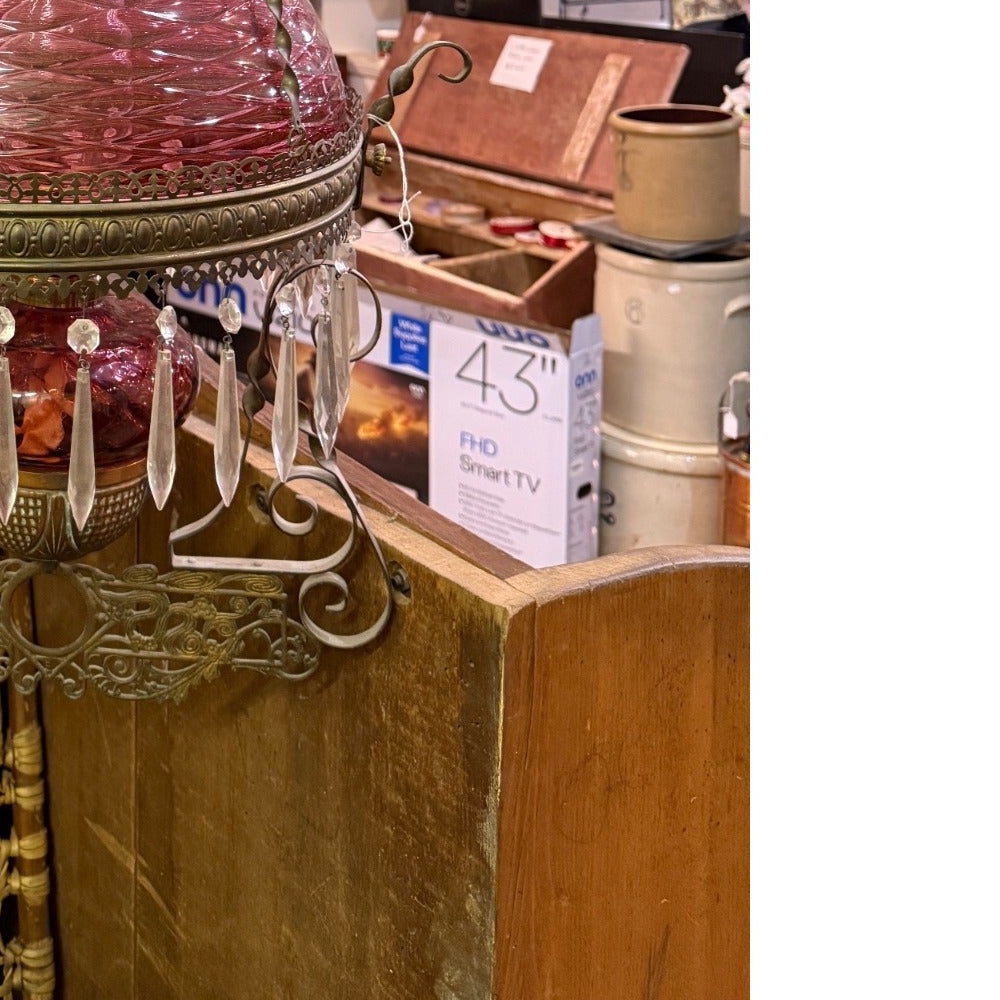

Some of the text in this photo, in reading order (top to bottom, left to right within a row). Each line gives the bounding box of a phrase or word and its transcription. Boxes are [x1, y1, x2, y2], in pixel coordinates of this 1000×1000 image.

[455, 340, 556, 415] 43"
[459, 430, 498, 457] FHD
[459, 454, 541, 494] Smart TV
